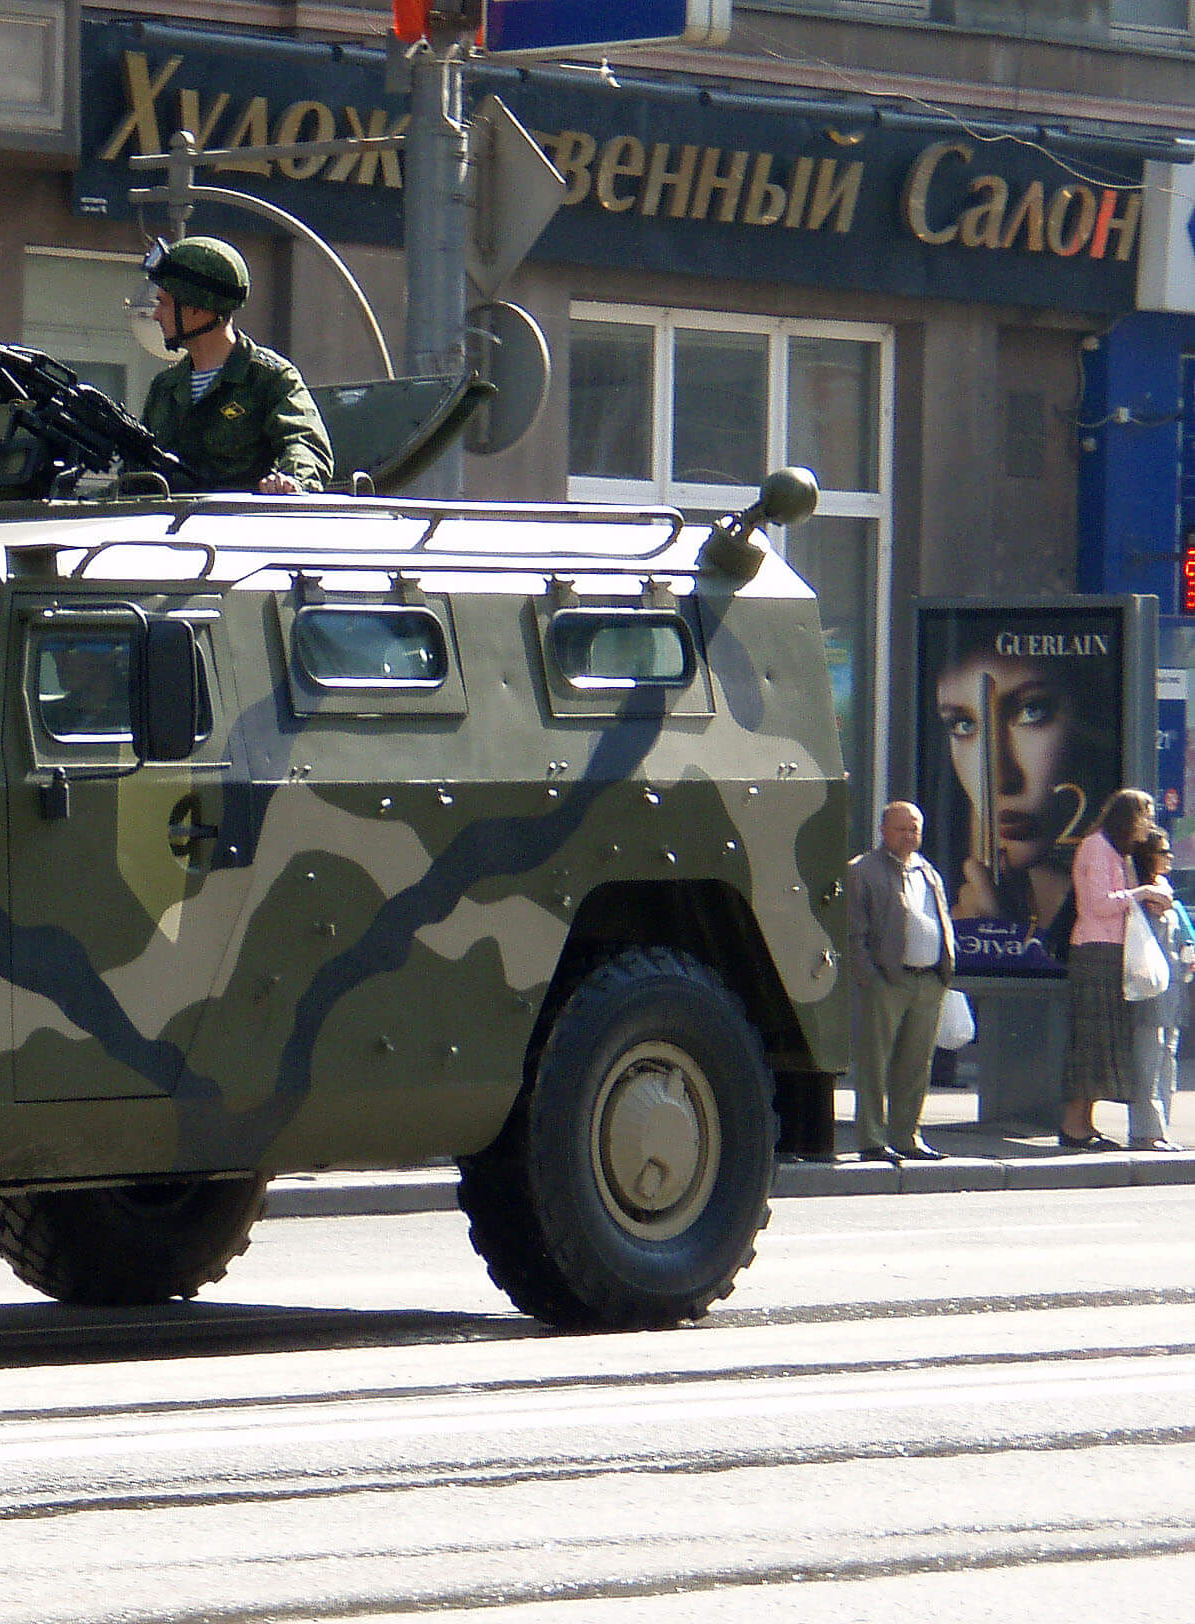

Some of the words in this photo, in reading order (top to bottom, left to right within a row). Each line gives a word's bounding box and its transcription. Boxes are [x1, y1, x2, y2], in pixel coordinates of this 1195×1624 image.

[100, 50, 865, 234] Художвенный
[908, 140, 1142, 262] Салон
[996, 631, 1109, 656] GUERLAIN
[1053, 783, 1087, 845] 2
